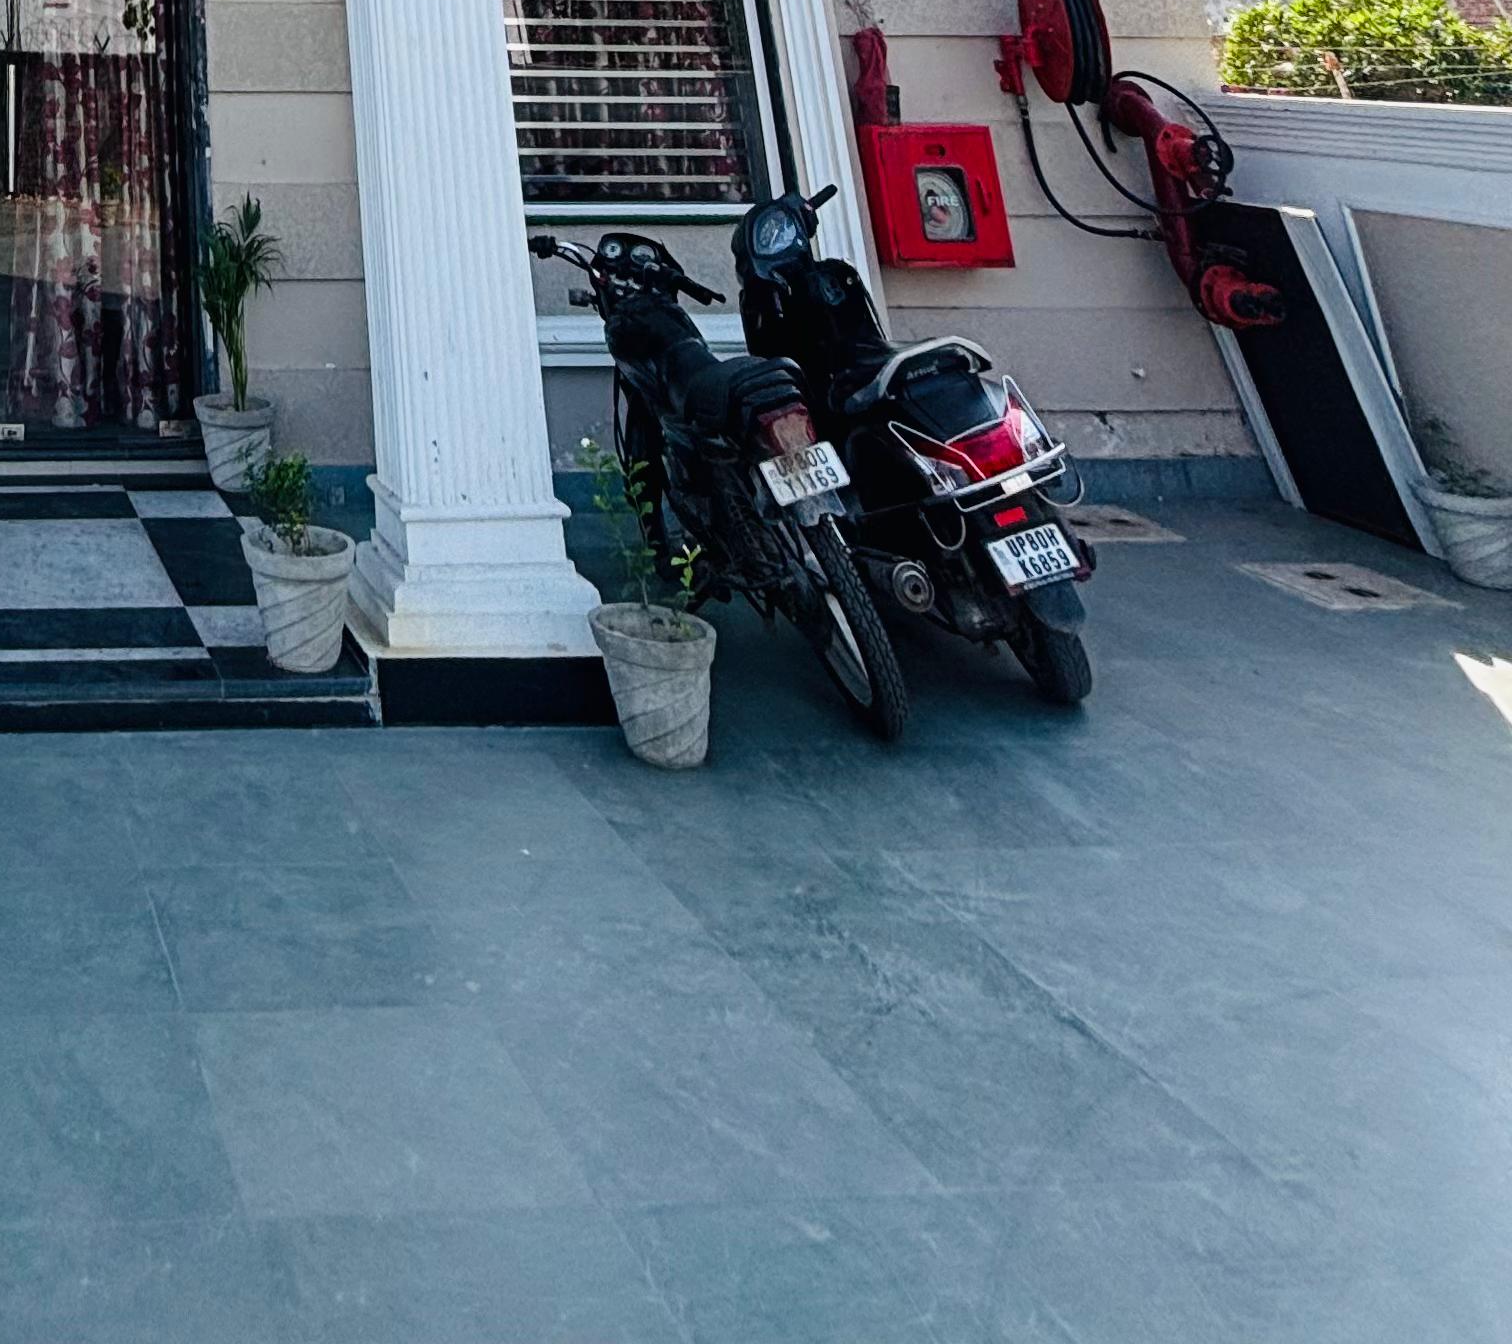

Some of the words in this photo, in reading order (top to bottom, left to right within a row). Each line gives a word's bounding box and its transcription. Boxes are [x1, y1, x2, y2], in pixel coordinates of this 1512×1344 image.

[927, 195, 960, 207] FIRE
[1005, 527, 1060, 558] UP80H
[1017, 548, 1071, 579] K6859
